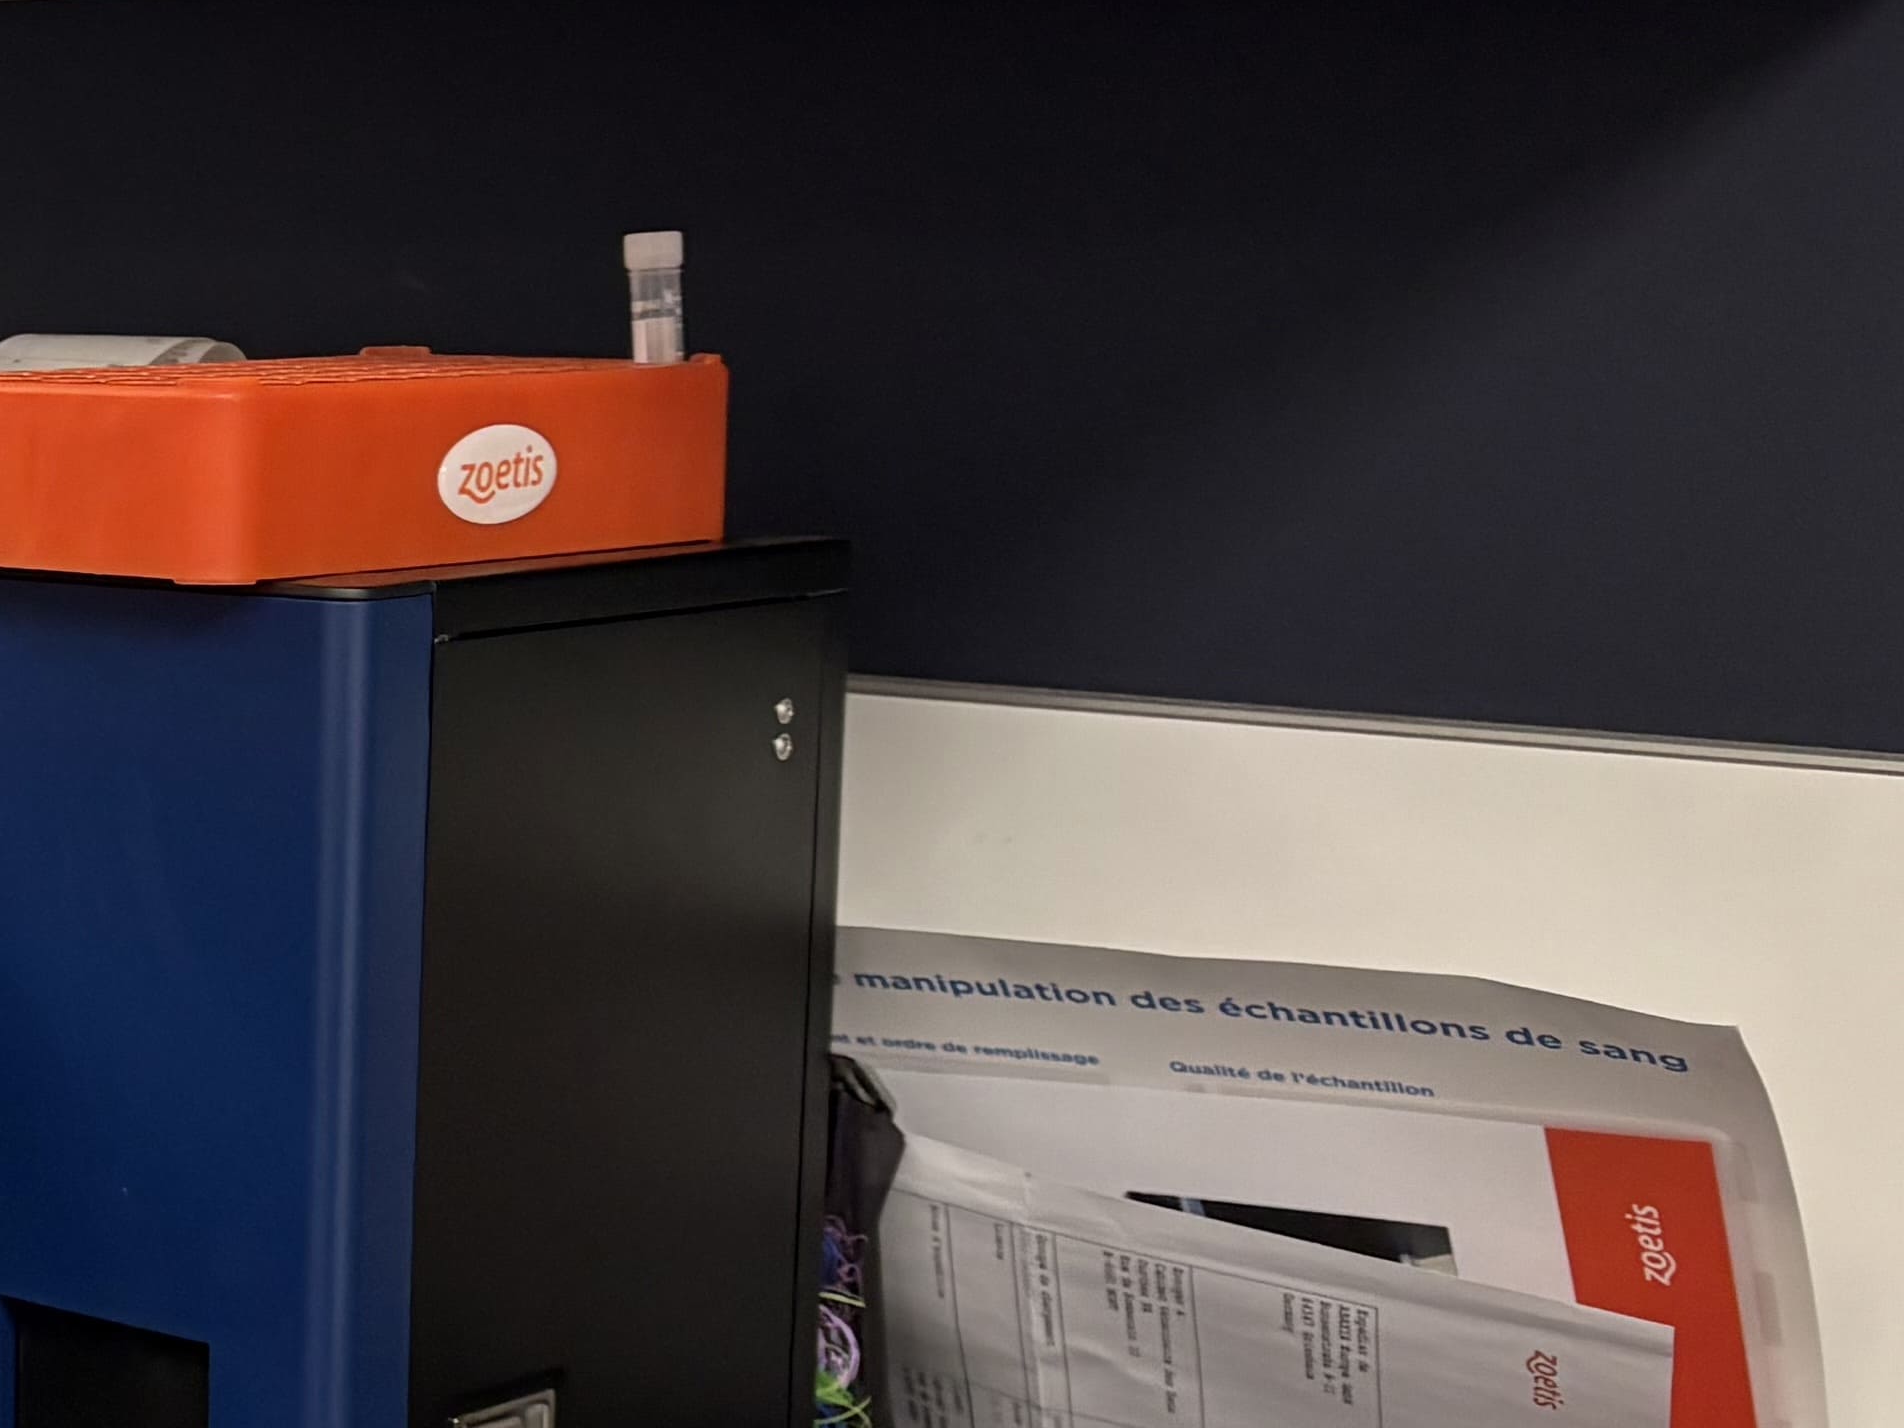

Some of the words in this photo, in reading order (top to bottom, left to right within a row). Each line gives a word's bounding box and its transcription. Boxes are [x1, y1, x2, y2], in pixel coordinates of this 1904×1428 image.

[458, 445, 544, 504] zoetis
[853, 970, 1117, 1007] manipulation
[1131, 989, 1205, 1015] des
[1218, 995, 1492, 1042] échantillons
[1505, 1027, 1564, 1050] de
[1578, 1039, 1690, 1074] sang
[882, 1037, 936, 1051] ordre
[942, 1041, 968, 1054] de
[973, 1044, 1101, 1066] remplissage
[1169, 1060, 1250, 1080] Qualité
[1256, 1068, 1285, 1084] de
[1291, 1070, 1436, 1098] l'échantillon
[1625, 1203, 1677, 1286] zoetis
[1523, 1350, 1567, 1410] zoetis
